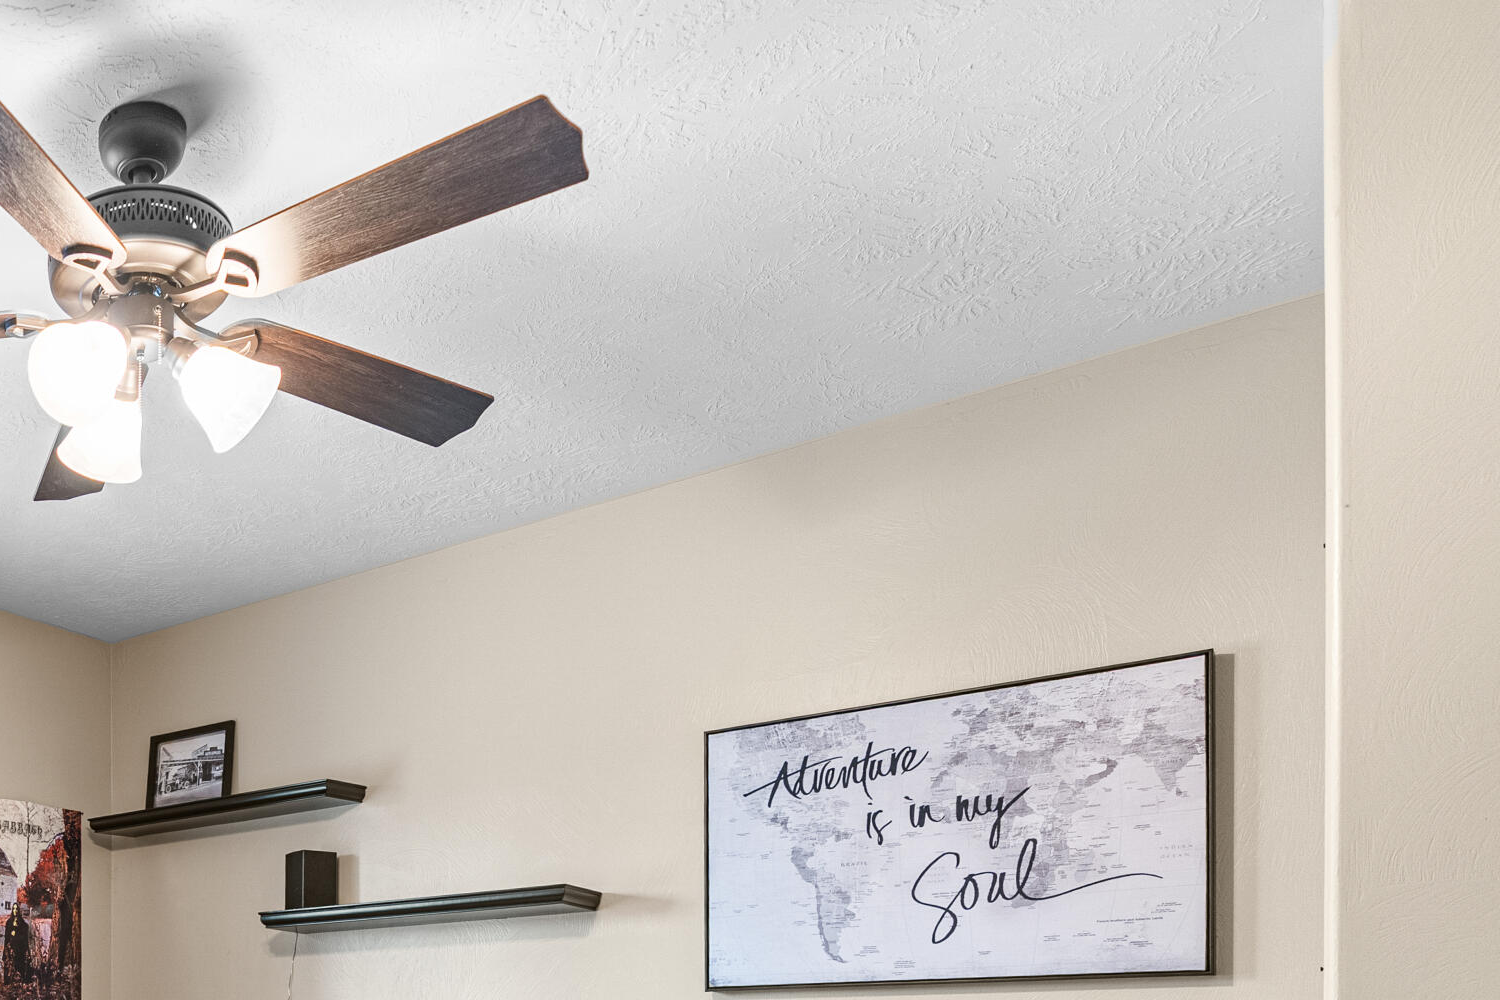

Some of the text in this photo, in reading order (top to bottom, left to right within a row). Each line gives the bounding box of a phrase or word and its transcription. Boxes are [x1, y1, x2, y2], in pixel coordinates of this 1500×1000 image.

[743, 741, 931, 809] Adventure
[866, 786, 1031, 849] is in my
[911, 838, 1163, 945] Soul
